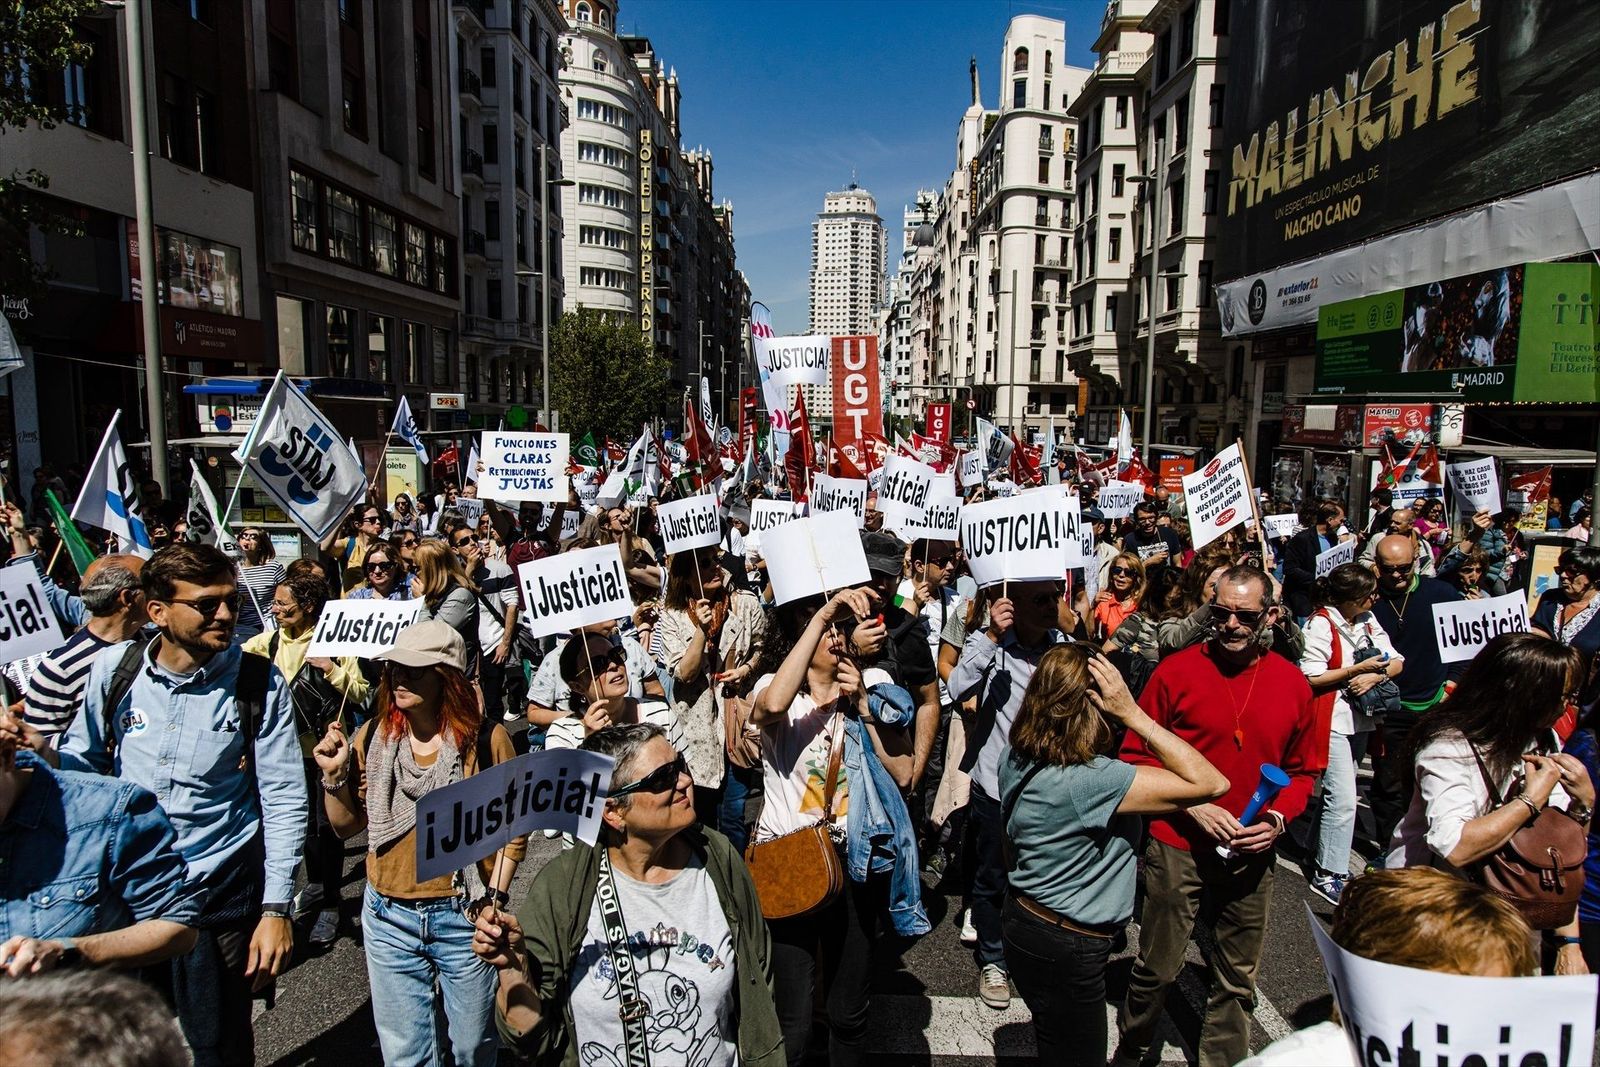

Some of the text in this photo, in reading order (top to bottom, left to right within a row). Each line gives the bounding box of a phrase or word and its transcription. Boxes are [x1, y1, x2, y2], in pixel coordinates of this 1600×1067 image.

[1227, 1, 1482, 217] MALINCHE
[1274, 207, 1284, 220] UN
[1332, 171, 1366, 196] MUSICAL
[1367, 164, 1380, 181] DE
[1284, 194, 1362, 241] NACHO CANO
[640, 129, 652, 358] HOTEL EMPERADO
[768, 347, 829, 374] JUSTICIA!
[1552, 342, 1591, 353] Teatro
[843, 338, 869, 440] UGT
[1463, 372, 1505, 386] MADRID
[932, 406, 945, 441] UGT
[1368, 407, 1400, 417] MADRID
[495, 437, 557, 449] FUNCIONES
[279, 426, 337, 491] STAJ
[503, 453, 552, 464] CLARAS
[1464, 468, 1475, 476] HAZ
[498, 477, 554, 490] JUSTAS
[1188, 474, 1217, 496] NUESTRA
[1218, 456, 1242, 477] FUERZA
[1464, 481, 1479, 490] CAOS
[1099, 493, 1132, 509] JUSTICIA!
[1195, 492, 1225, 514] JUSTICIA
[1200, 491, 1209, 501] ES
[1200, 490, 1242, 523] EN LA LUCHA
[660, 504, 718, 543] ¡Justicia!
[966, 511, 1059, 560] JUSTICIA!
[1316, 547, 1353, 575] JUSTICIA!
[525, 560, 625, 620] ¡Justicia!
[121, 713, 143, 729] STAJ
[425, 767, 602, 861] ¡Justicia!
